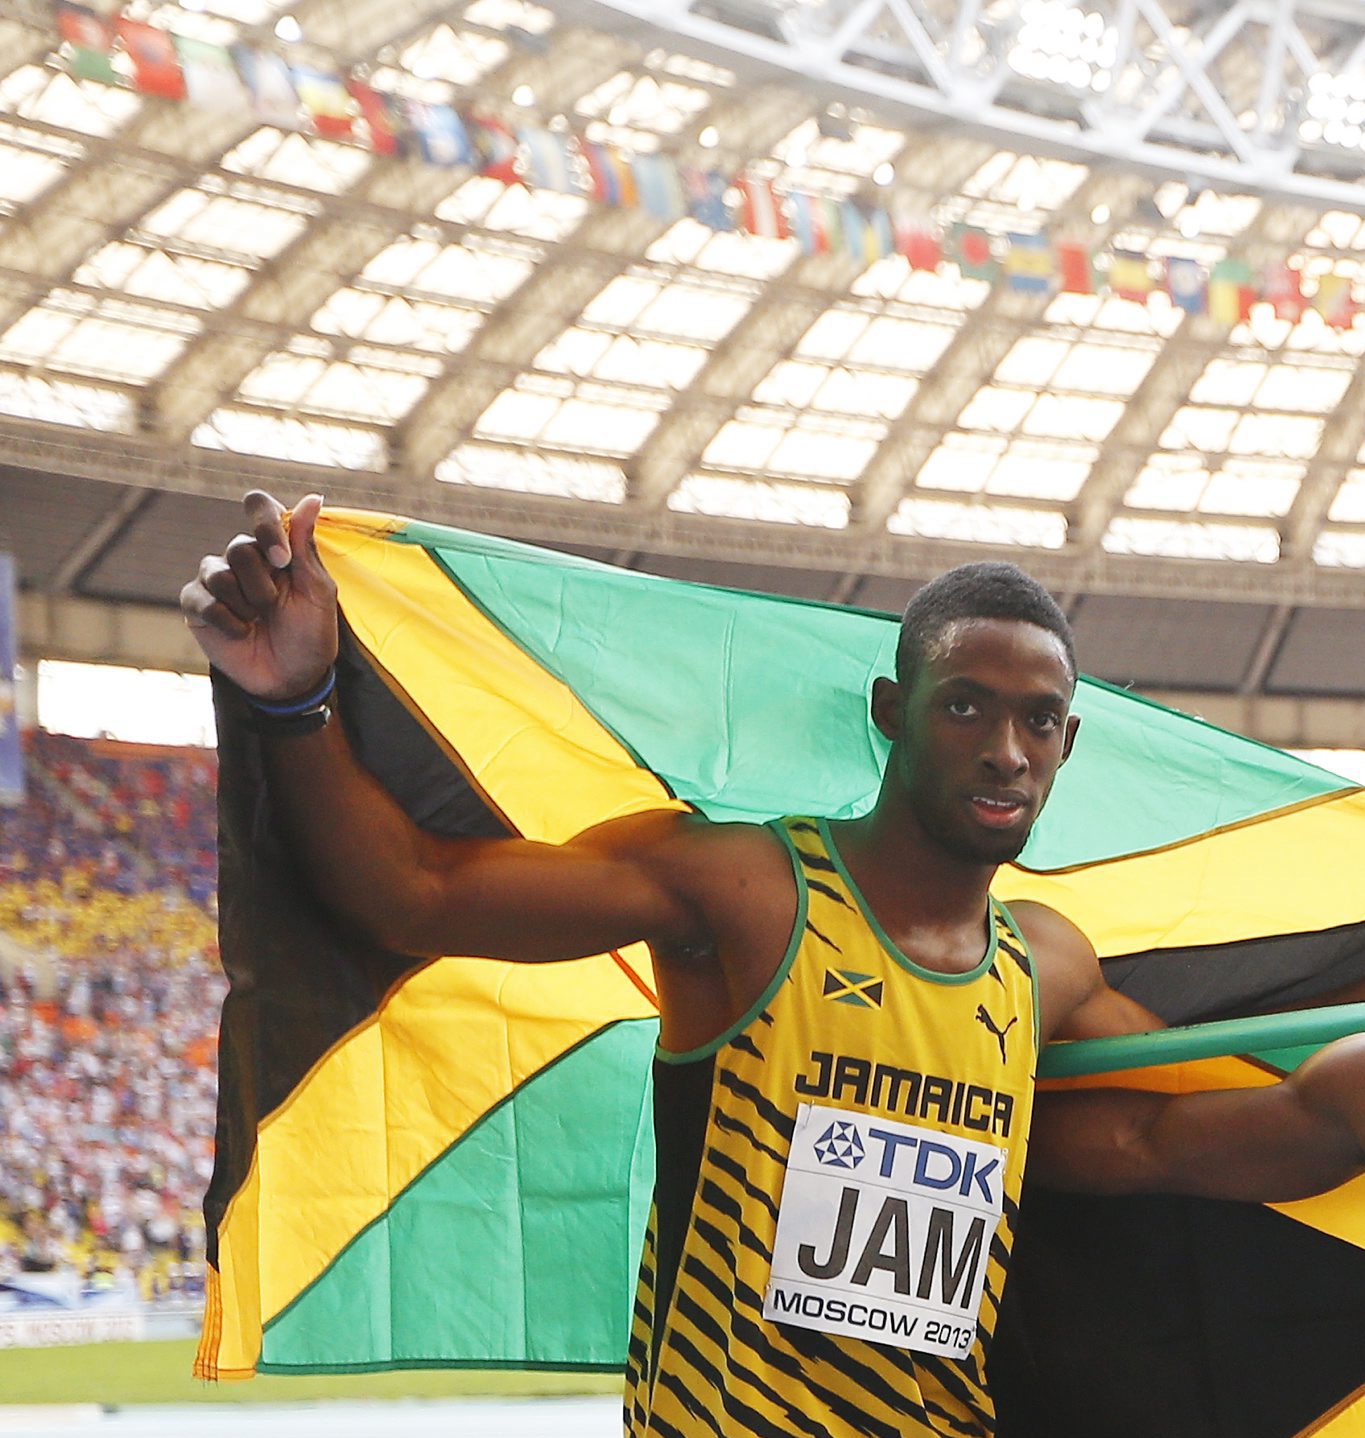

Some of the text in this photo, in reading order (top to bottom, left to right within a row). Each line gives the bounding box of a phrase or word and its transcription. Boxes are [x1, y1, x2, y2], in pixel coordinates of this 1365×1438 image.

[795, 1051, 1013, 1137] JAMAICA
[868, 1129, 1000, 1204] TDK
[797, 1187, 985, 1310] JAM
[773, 1289, 972, 1349] MOSCOW 2013
